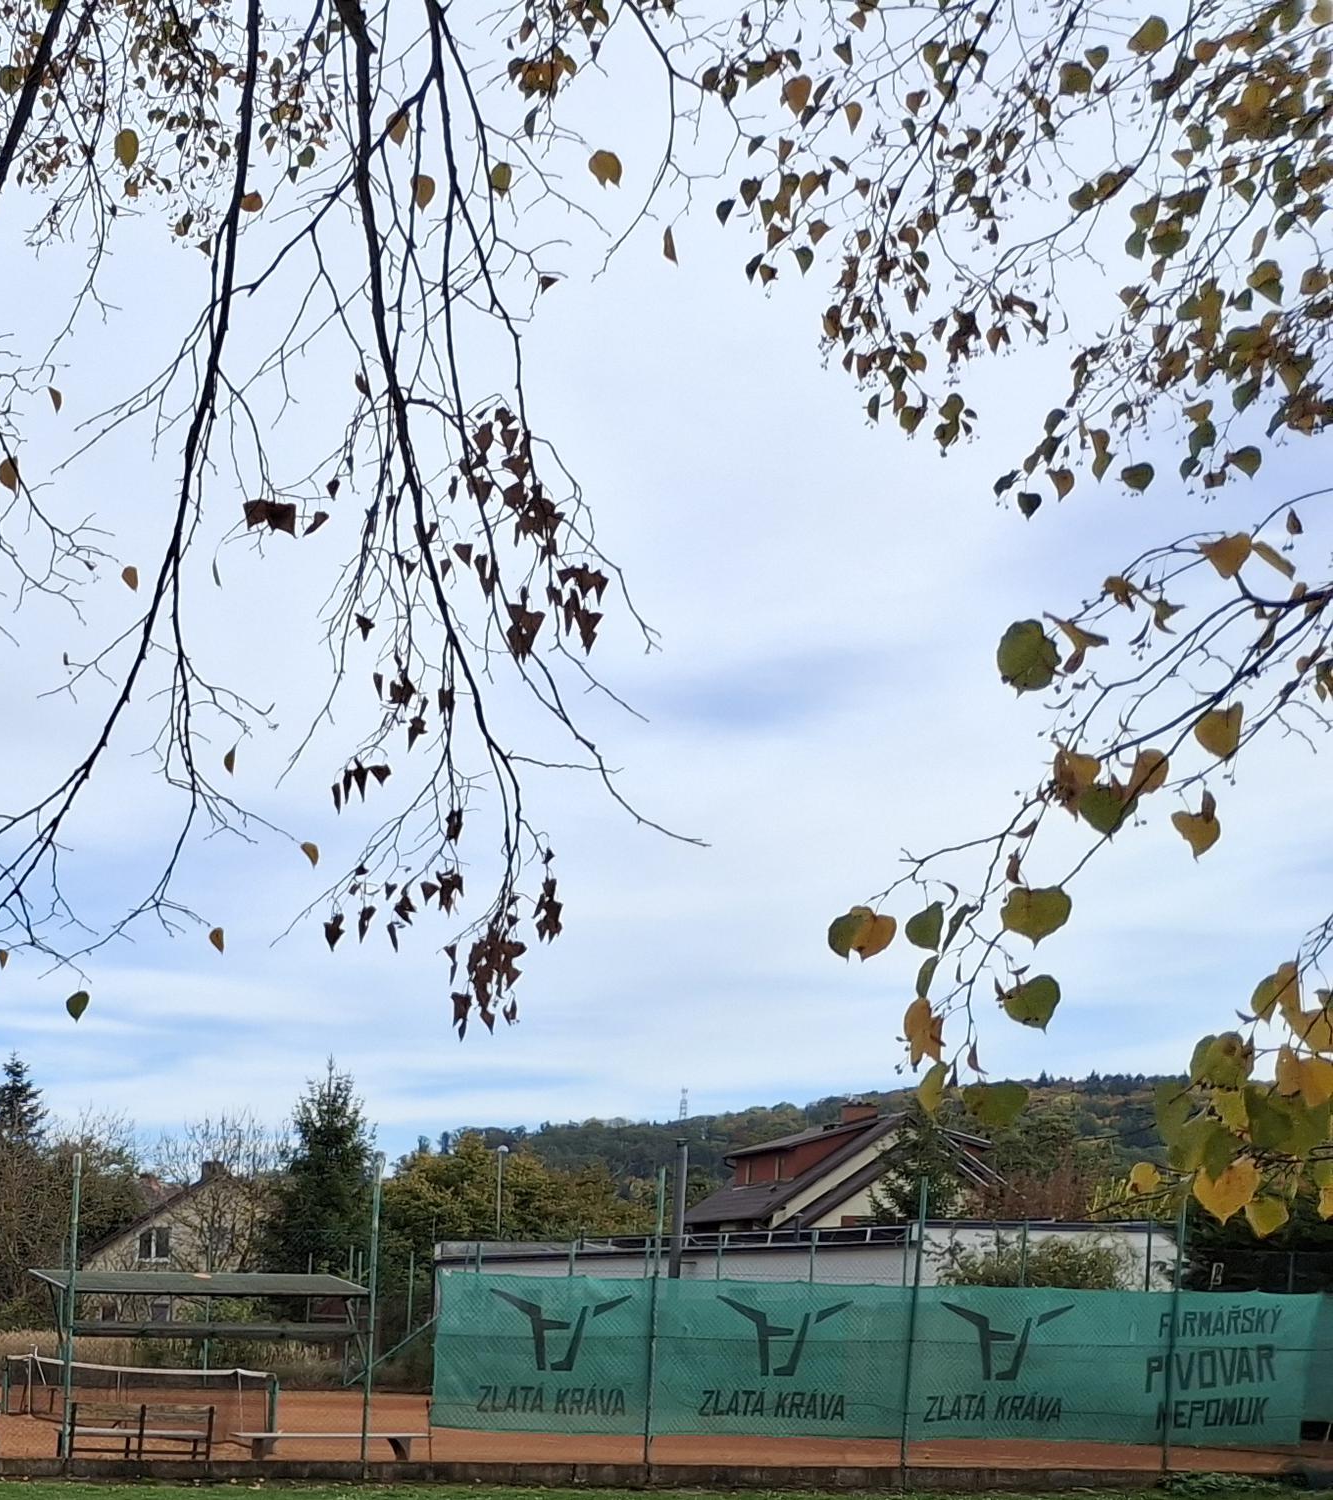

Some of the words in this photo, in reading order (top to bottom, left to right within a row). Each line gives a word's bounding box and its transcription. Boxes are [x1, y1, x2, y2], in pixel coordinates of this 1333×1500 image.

[476, 1381, 545, 1413] ZLATÁ
[553, 1383, 627, 1416] KRÁVA
[698, 1386, 766, 1417] ZLATÁ
[773, 1388, 846, 1421] KRÁVA
[923, 1390, 987, 1423] ZLATÁ
[993, 1391, 1063, 1423] KRÁVA
